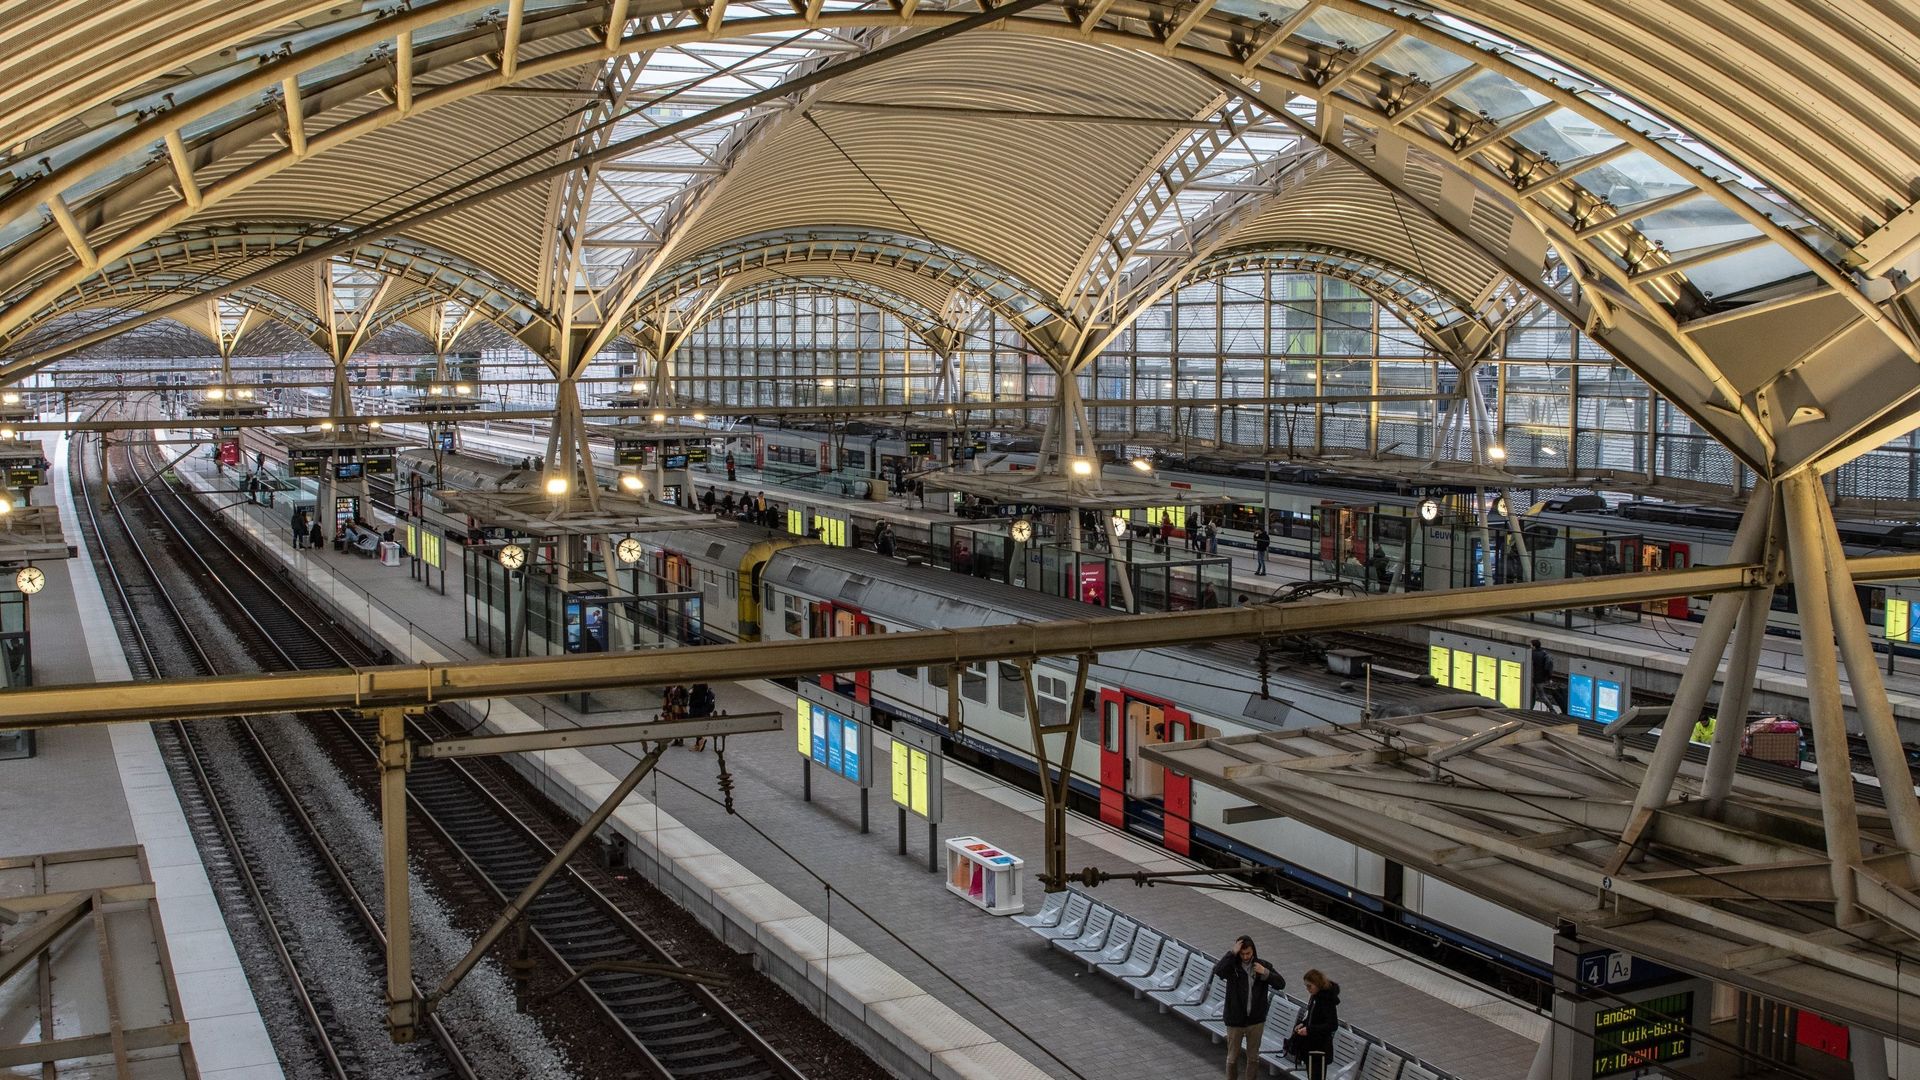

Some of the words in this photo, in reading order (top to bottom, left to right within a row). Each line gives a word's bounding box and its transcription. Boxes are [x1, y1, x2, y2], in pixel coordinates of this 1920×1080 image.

[803, 605, 808, 620] 2
[1588, 965, 1599, 984] 4
[1596, 1007, 1637, 1027] Landen
[1671, 1040, 1685, 1056] IC
